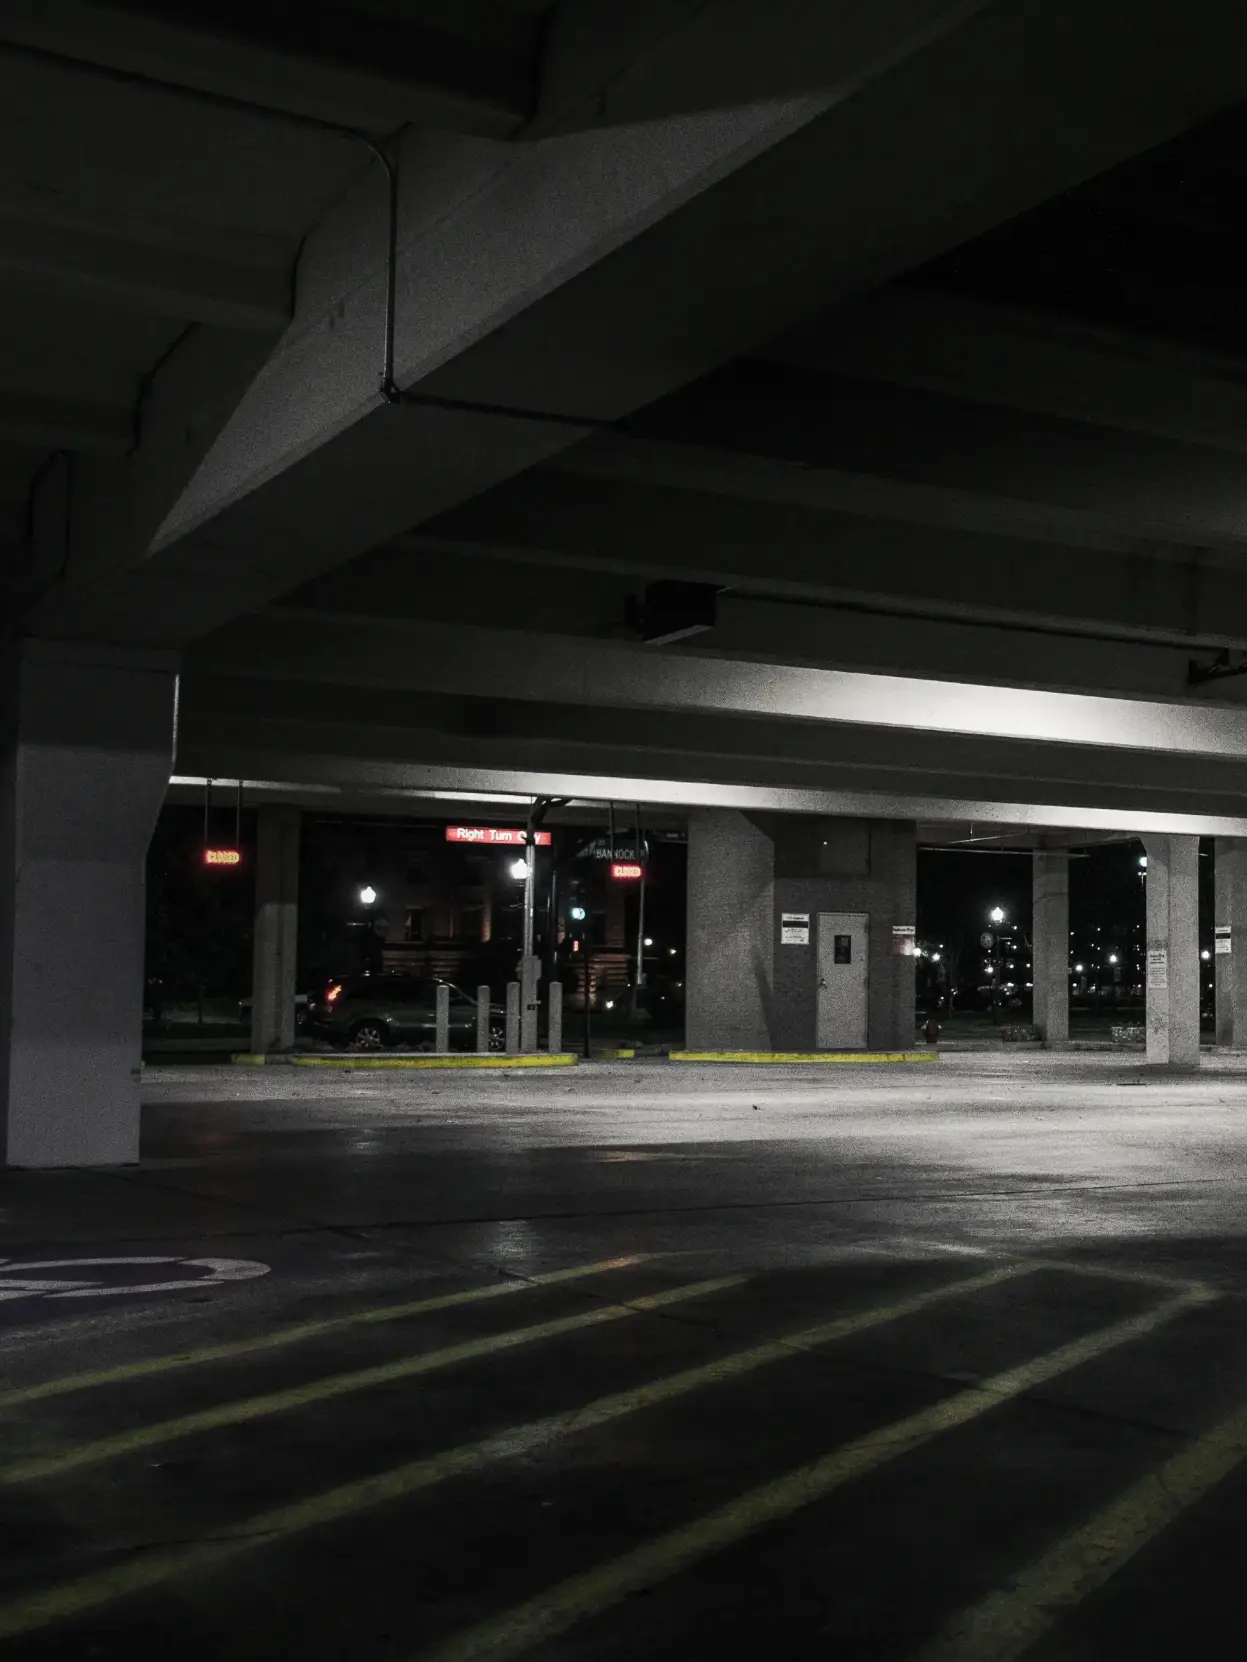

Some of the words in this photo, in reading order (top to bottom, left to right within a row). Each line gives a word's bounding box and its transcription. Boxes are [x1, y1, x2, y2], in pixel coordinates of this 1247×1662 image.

[456, 828, 485, 841] Right
[489, 830, 513, 841] Turn
[517, 831, 541, 845] Oy
